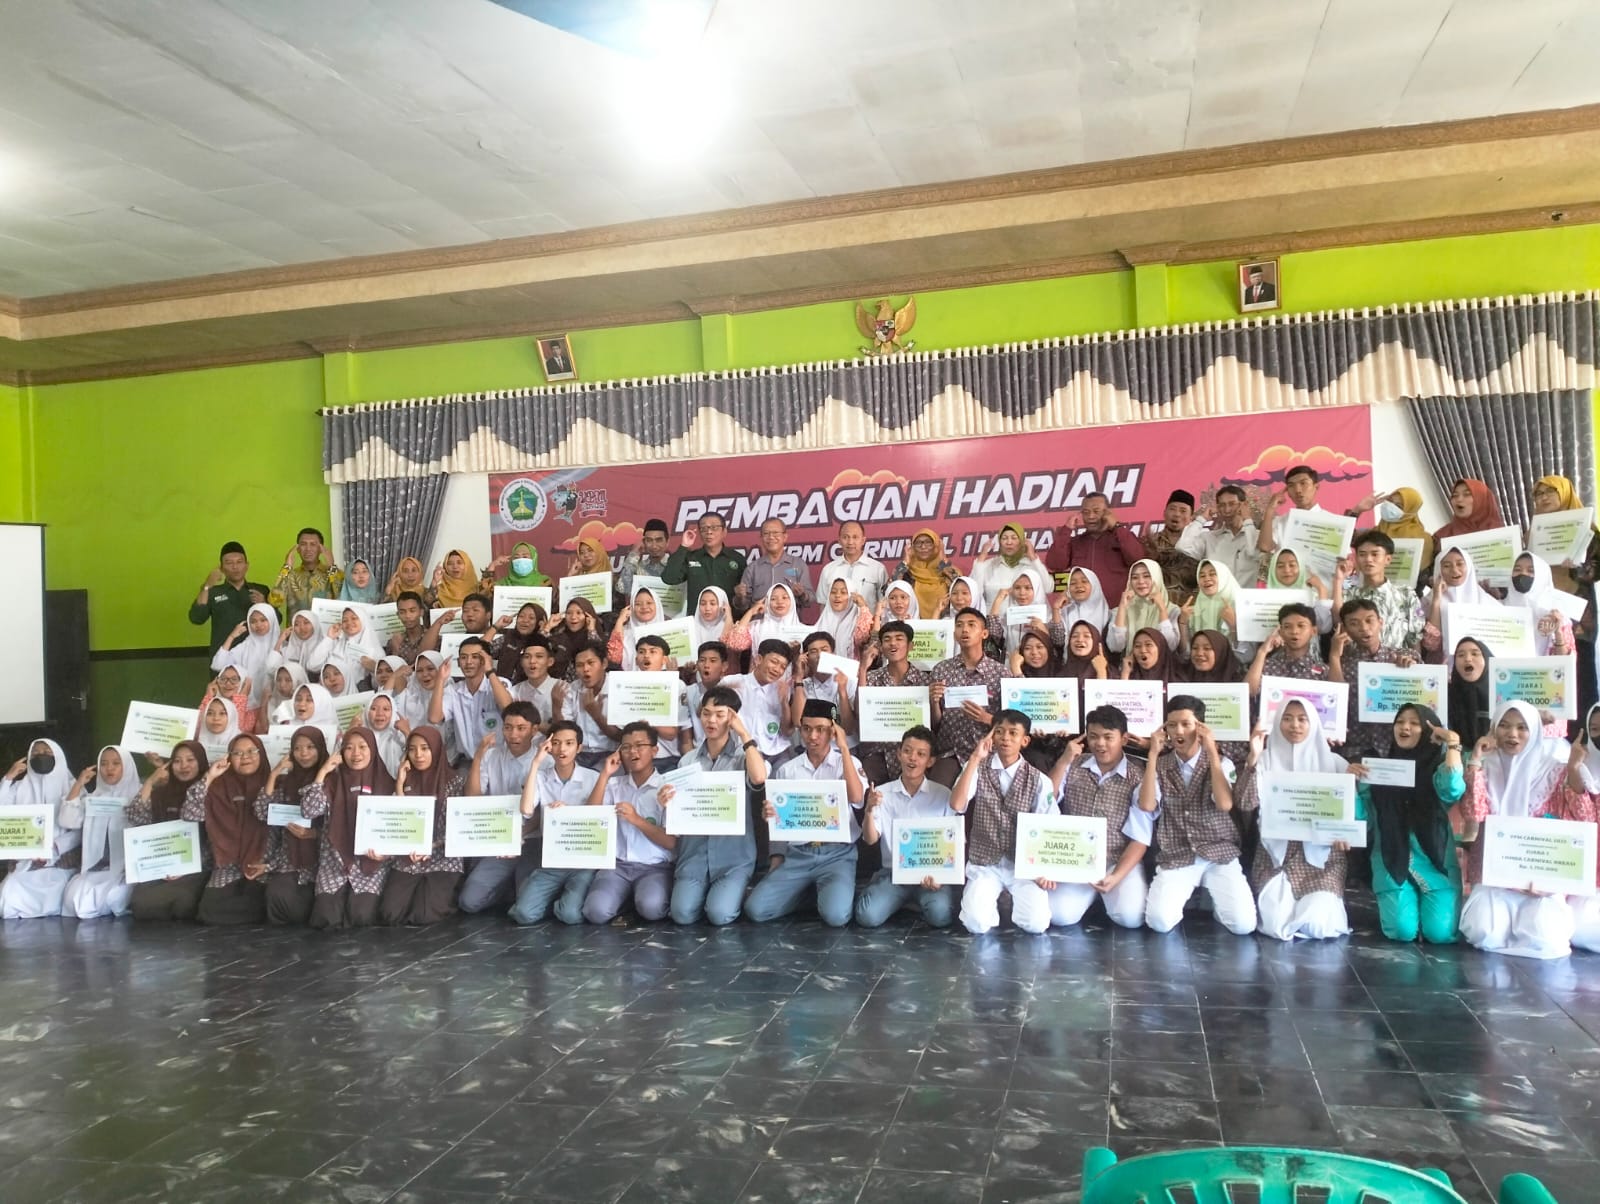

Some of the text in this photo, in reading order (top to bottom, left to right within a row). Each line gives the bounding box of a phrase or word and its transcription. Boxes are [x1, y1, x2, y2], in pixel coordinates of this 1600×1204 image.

[674, 466, 1142, 533] PEMBAGIAN HADIAH
[1029, 713, 1058, 721] 200.000
[785, 819, 827, 829] Rp. 400.000
[1044, 841, 1076, 851] JUARA 2
[908, 857, 944, 867] Rp. 300.000
